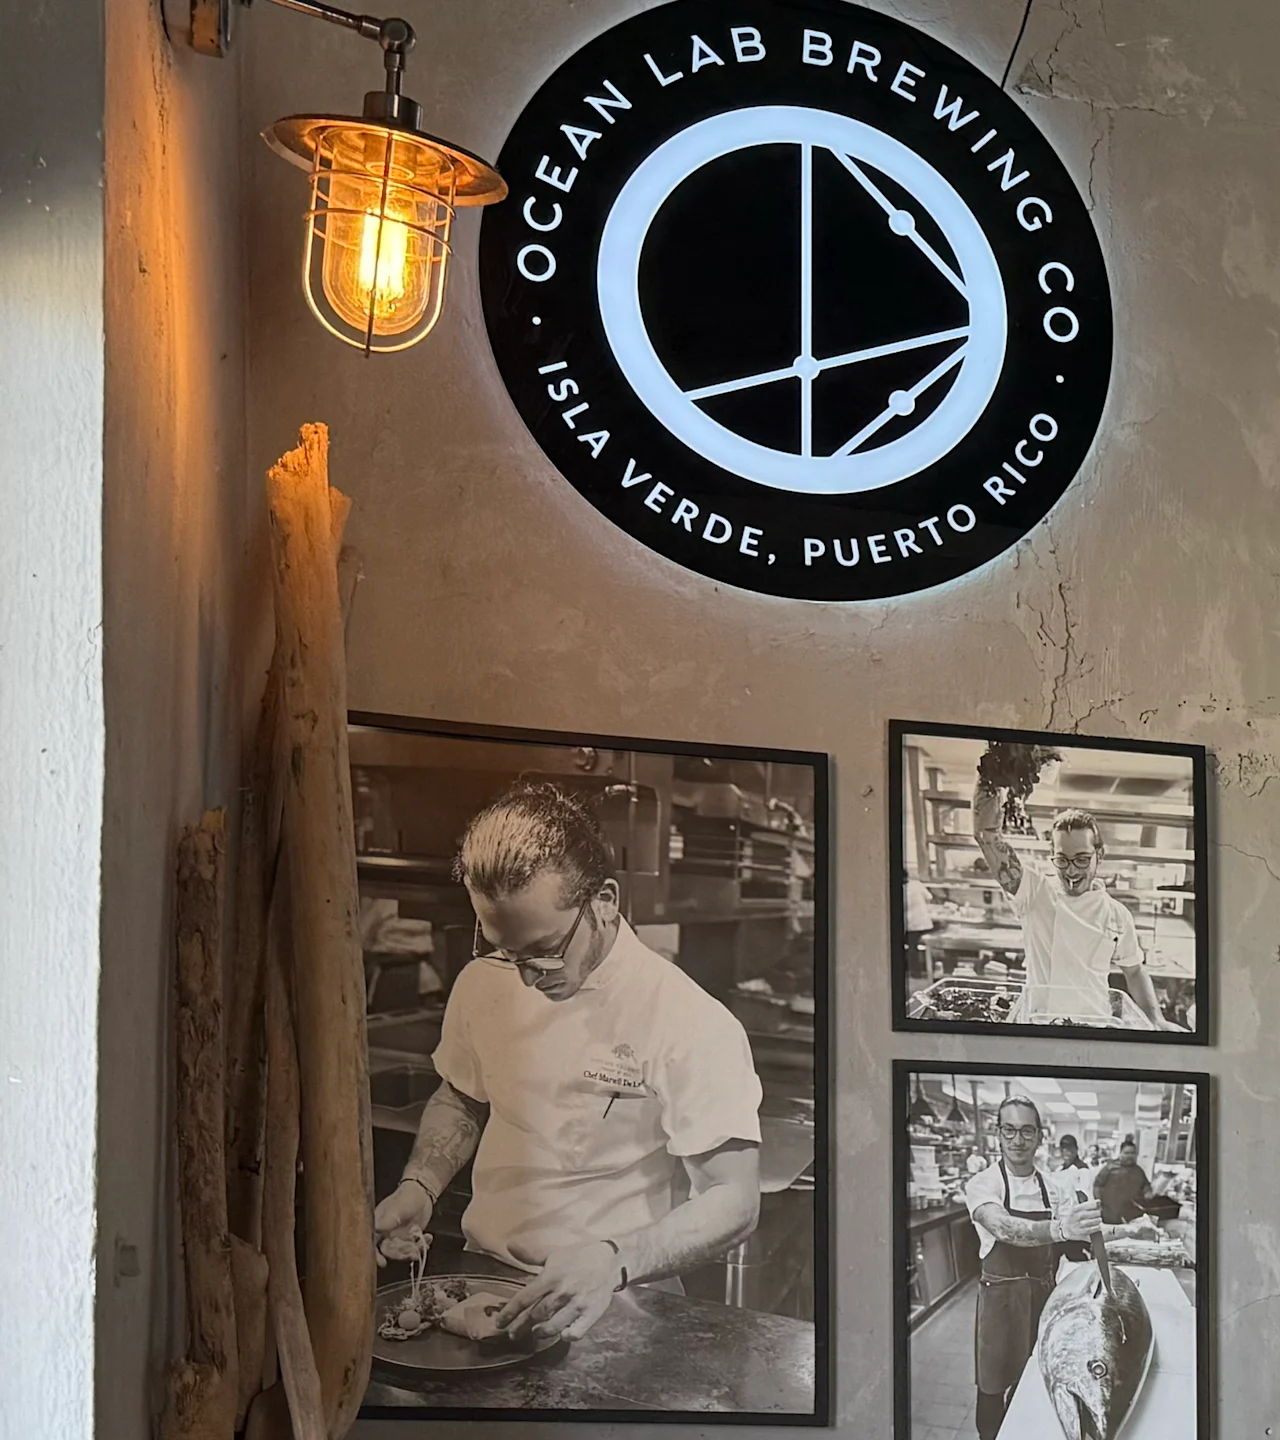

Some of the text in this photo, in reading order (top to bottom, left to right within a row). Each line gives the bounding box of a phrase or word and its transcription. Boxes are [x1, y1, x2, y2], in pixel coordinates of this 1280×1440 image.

[517, 26, 1080, 343] OCEAN LAB BREWING CO
[537, 360, 1059, 568] ISLA VERDE, PUERTO RICO
